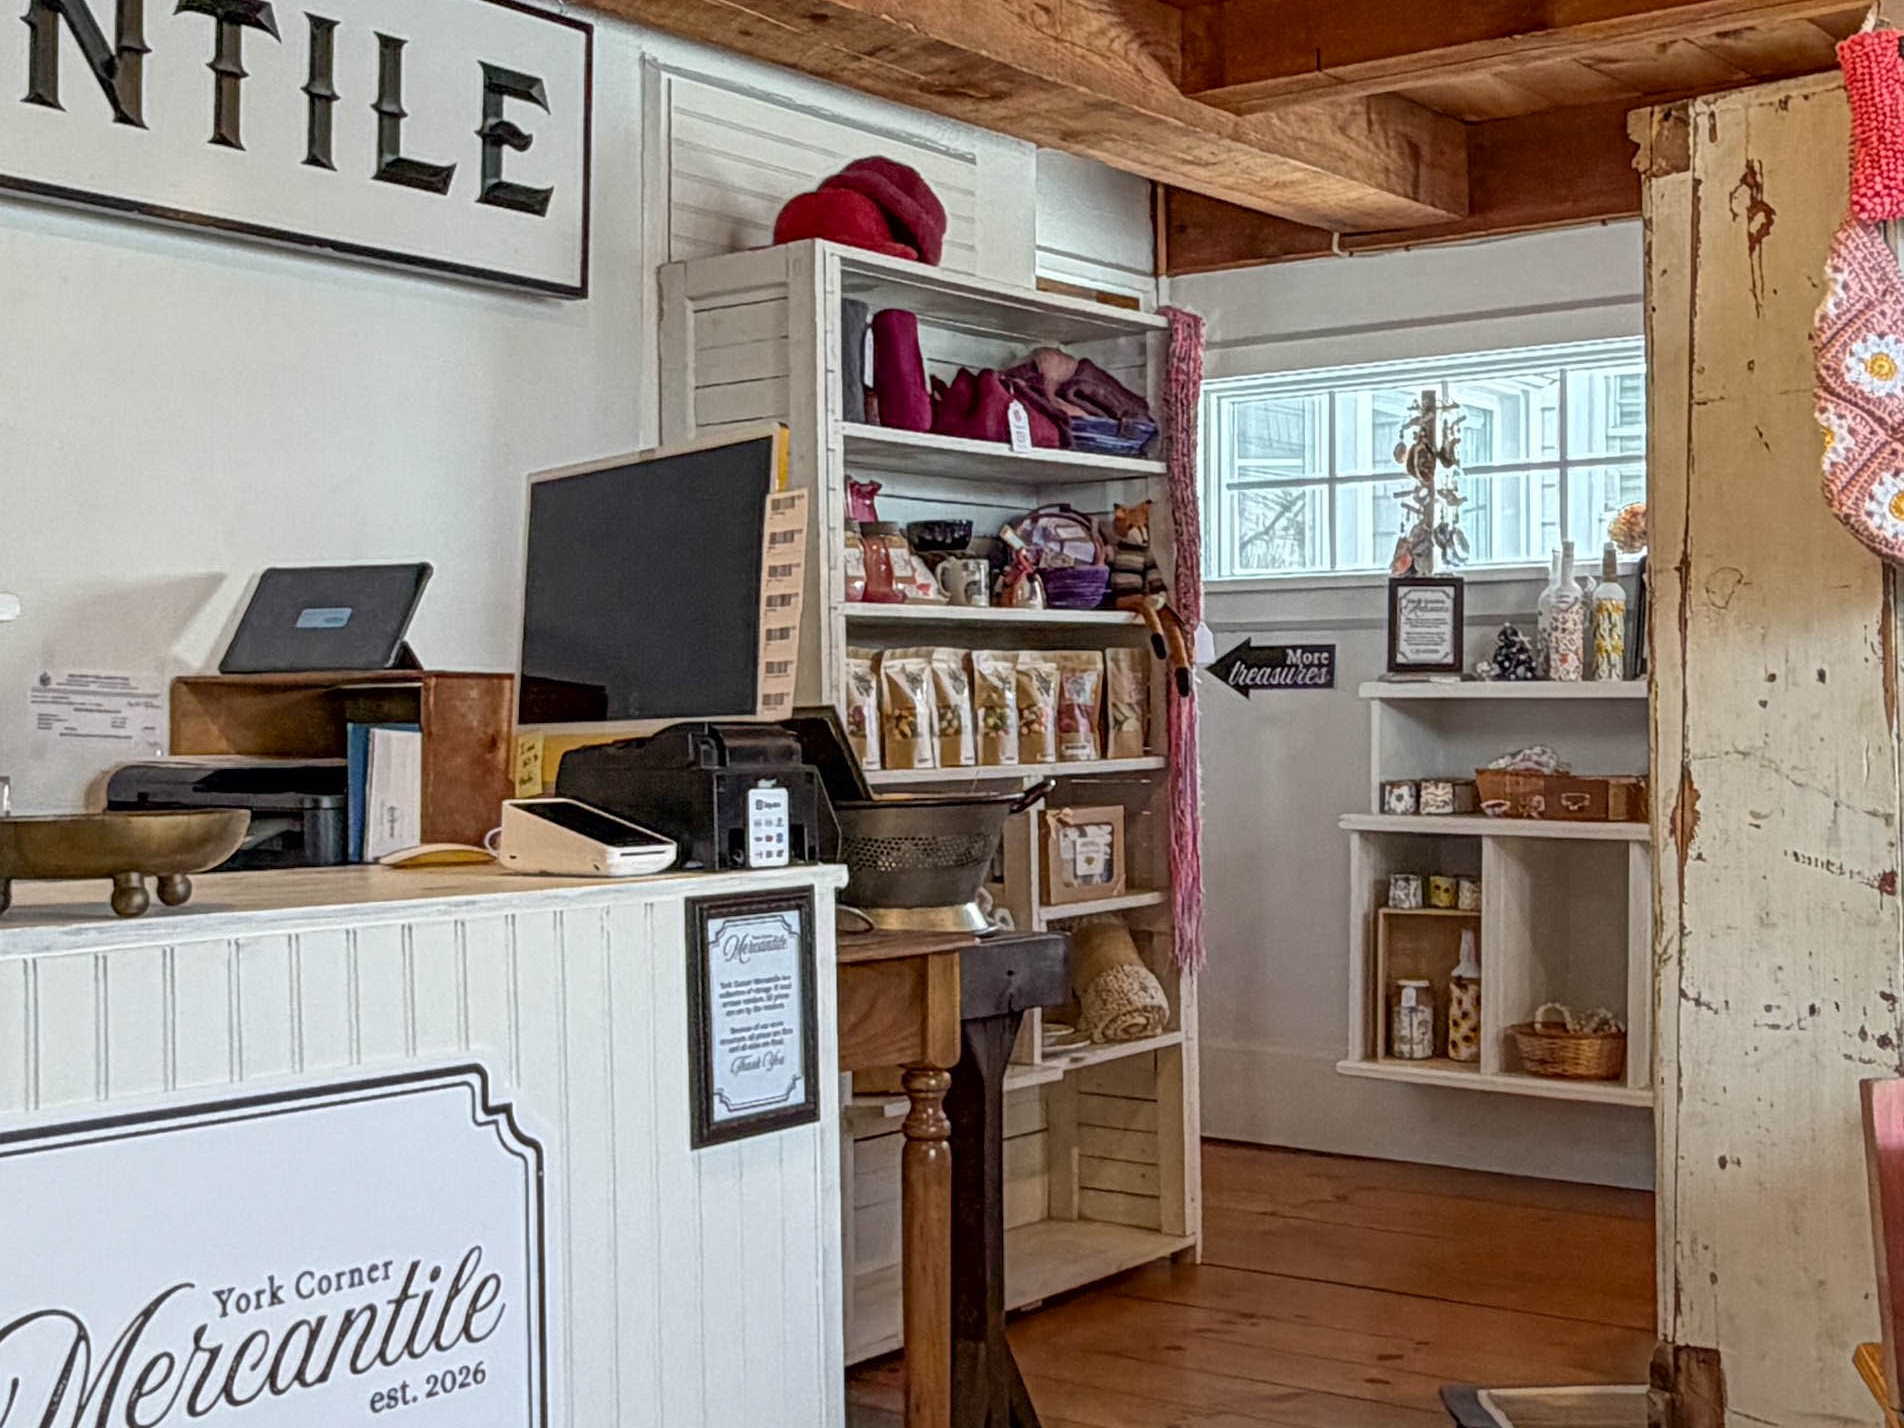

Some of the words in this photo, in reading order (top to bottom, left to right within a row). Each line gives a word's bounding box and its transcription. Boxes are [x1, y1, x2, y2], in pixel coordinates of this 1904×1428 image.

[1228, 660, 1328, 686] treasures
[1286, 649, 1330, 665] More
[213, 1276, 285, 1319] York
[295, 1259, 393, 1301] Corner
[369, 1379, 418, 1414] est.
[425, 1360, 487, 1399] 2026
